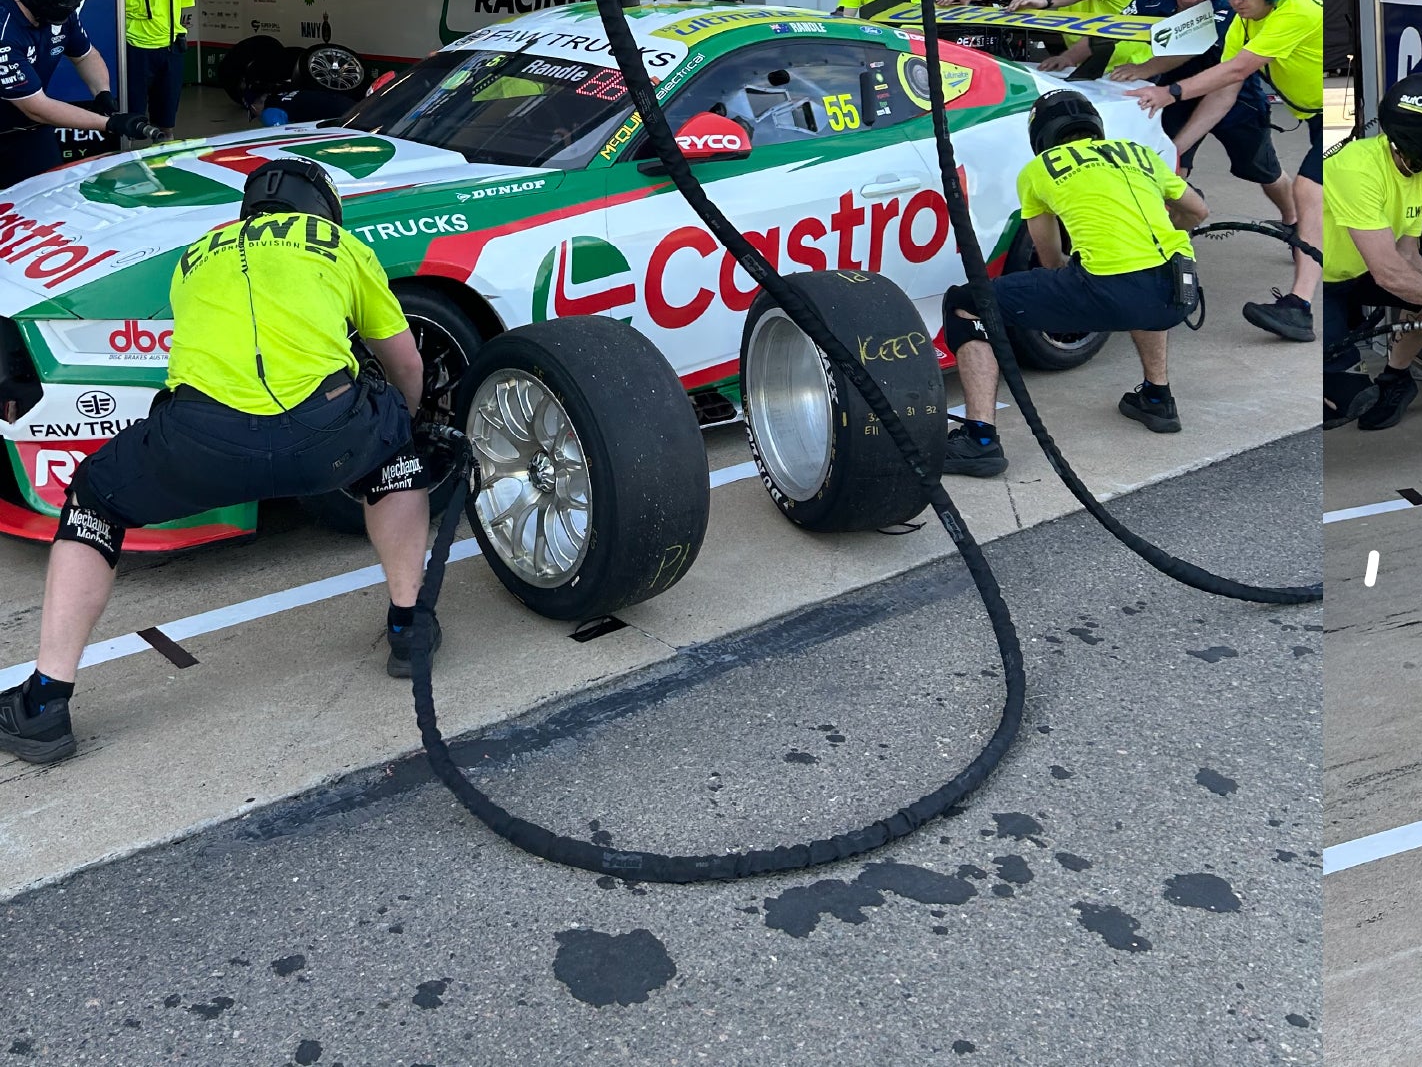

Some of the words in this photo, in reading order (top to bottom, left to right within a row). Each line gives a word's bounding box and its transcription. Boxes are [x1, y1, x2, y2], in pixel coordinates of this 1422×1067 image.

[301, 22, 321, 38] NAVY
[788, 21, 828, 34] RANDLE
[1174, 20, 1195, 34] SUPER
[1196, 12, 1213, 24] SPILL
[521, 60, 589, 83] Randle
[656, 52, 706, 101] electrical
[822, 92, 860, 132] 55
[675, 134, 741, 150] RYCO
[1042, 141, 1156, 182] ELWD
[470, 180, 546, 200] DUNLOP
[362, 213, 469, 243] TRUCKS
[180, 214, 341, 279] ELWD
[248, 240, 301, 250] DIVISION
[857, 331, 925, 365] KEEP
[30, 423, 88, 437] FAW
